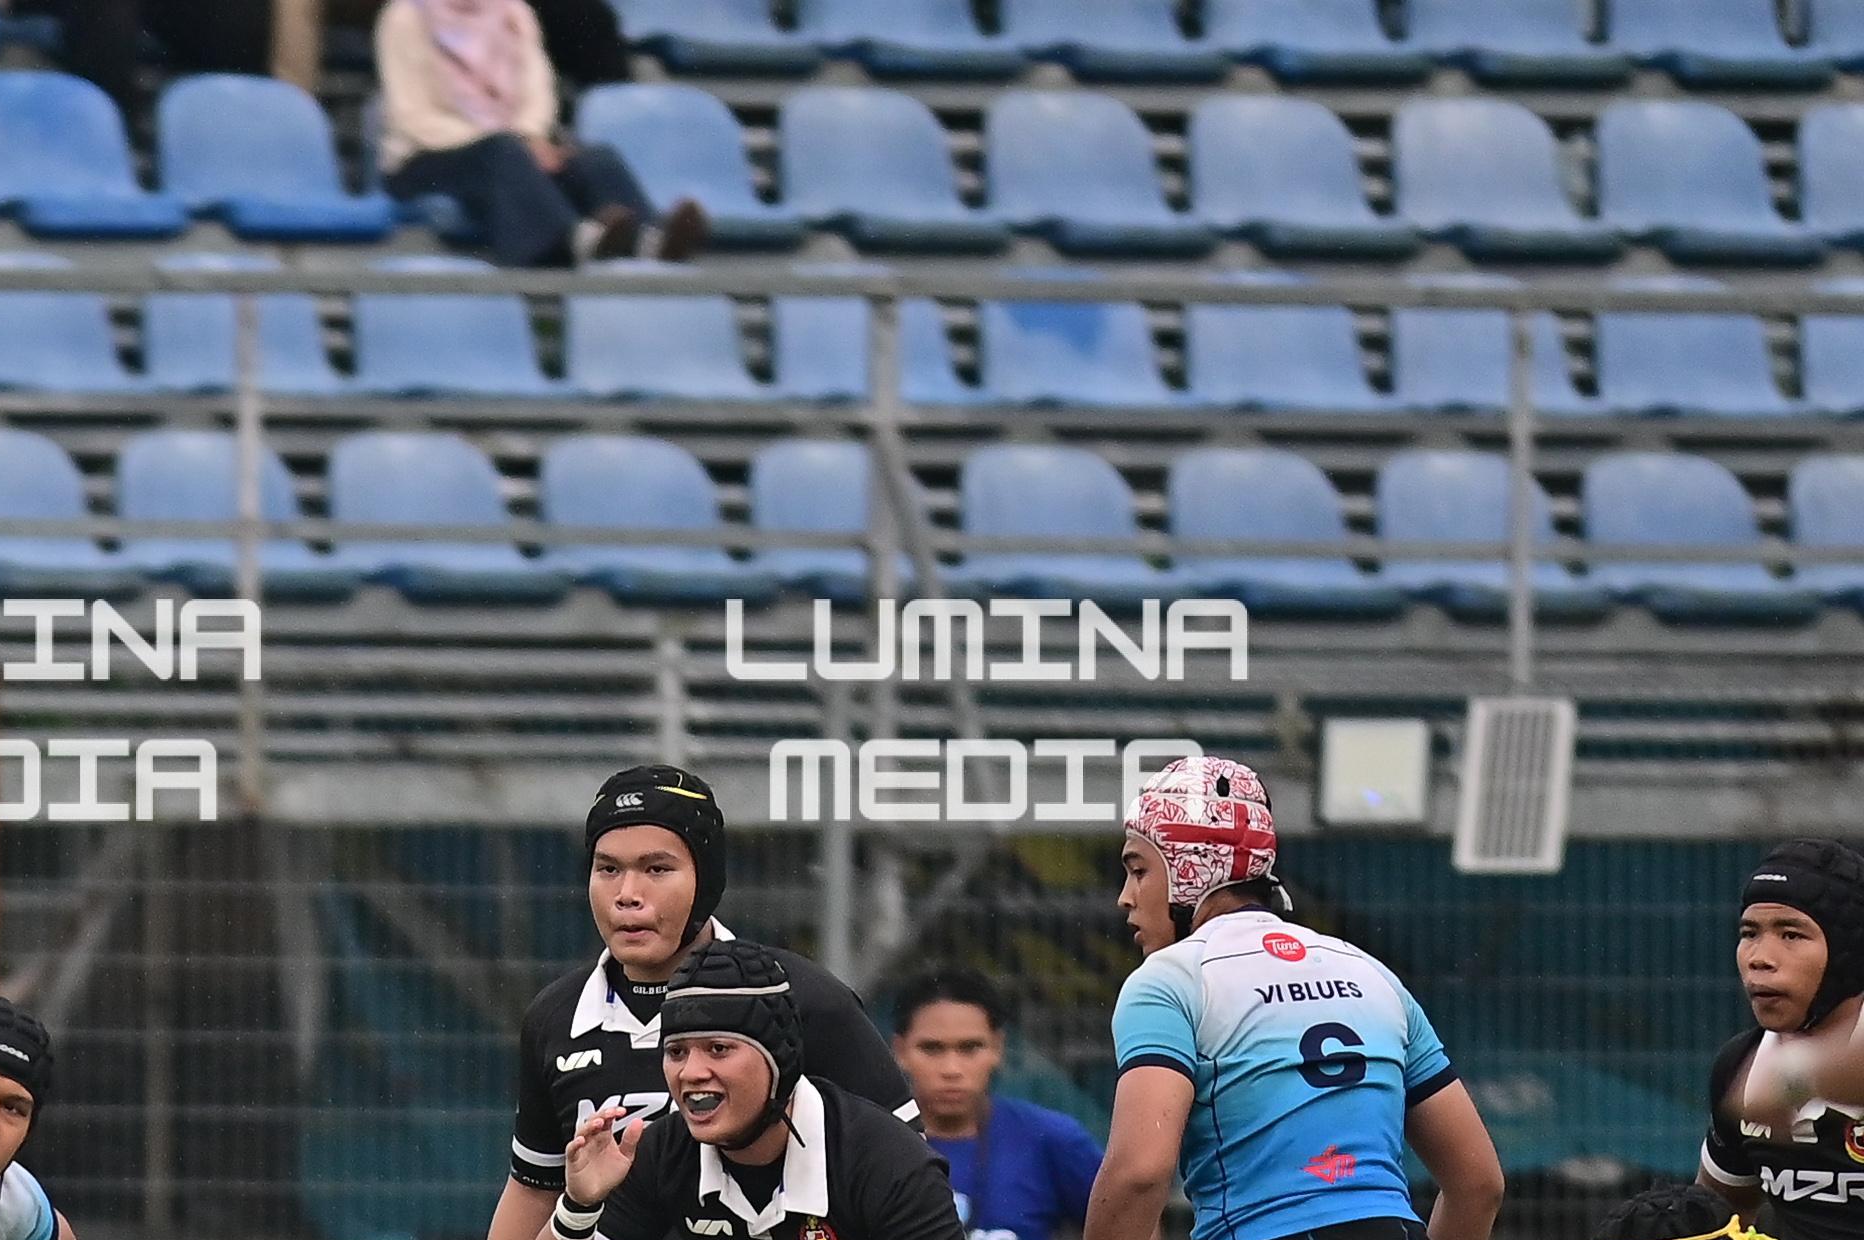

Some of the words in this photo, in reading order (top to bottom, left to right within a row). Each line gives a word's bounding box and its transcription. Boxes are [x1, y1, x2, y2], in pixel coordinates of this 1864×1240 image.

[632, 985, 669, 995] GILBER
[1254, 983, 1285, 1005] VI
[1288, 980, 1364, 1002] BLUES
[1297, 1021, 1368, 1089] 6
[575, 1092, 680, 1136] MZ
